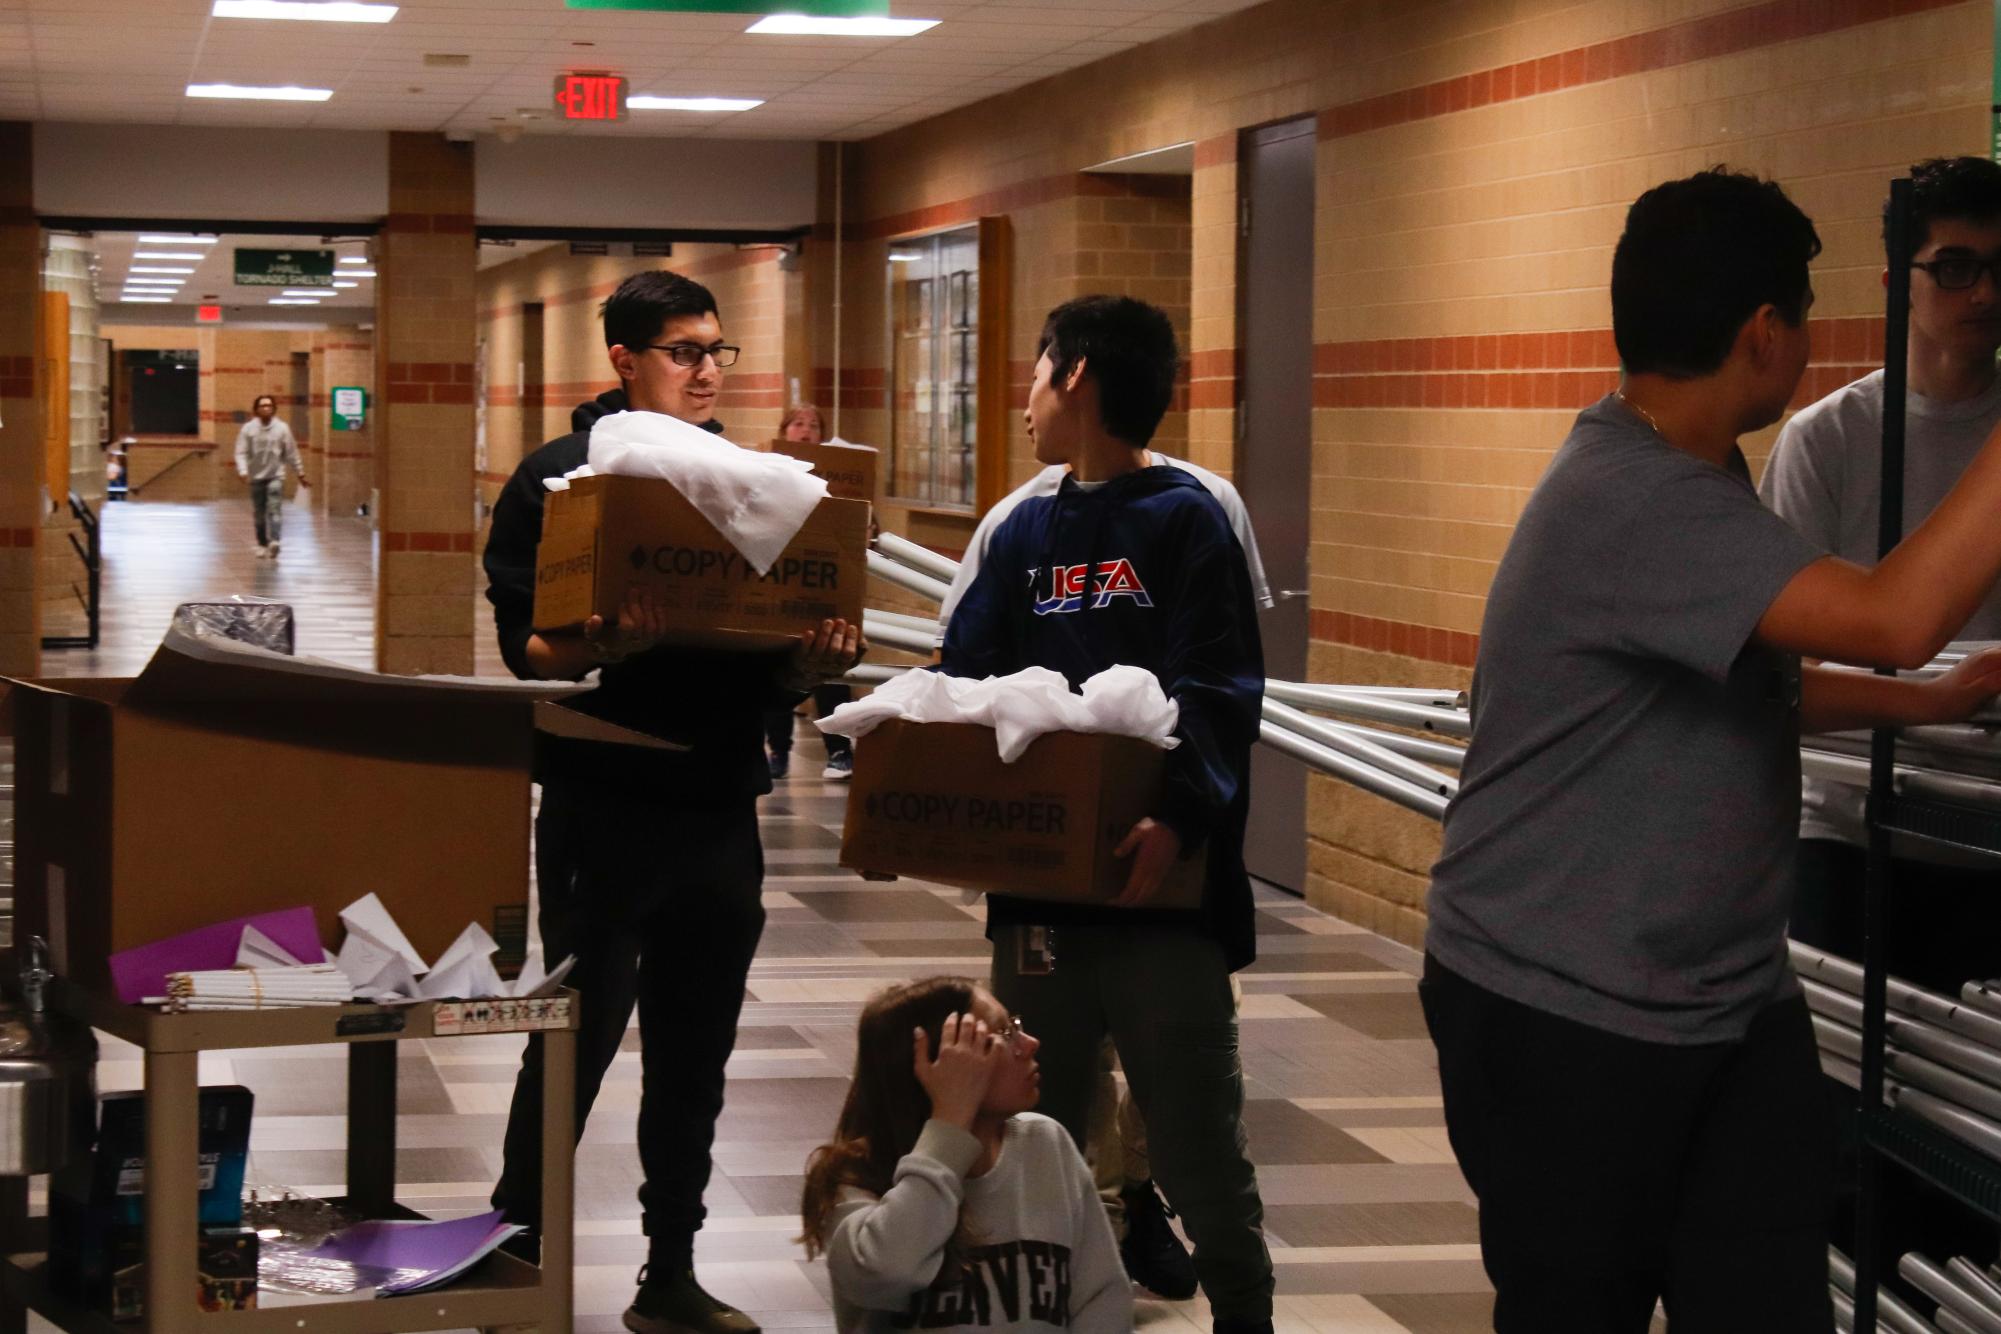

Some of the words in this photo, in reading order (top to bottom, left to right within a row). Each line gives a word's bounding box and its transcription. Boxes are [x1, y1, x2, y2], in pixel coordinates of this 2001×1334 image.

[565, 77, 621, 119] EXIT
[237, 273, 288, 285] TORNADO
[289, 274, 333, 286] SHELTER
[652, 545, 736, 579] COPY
[1026, 558, 1154, 615] USA
[881, 791, 959, 825] COPY
[968, 797, 1067, 835] PAPER
